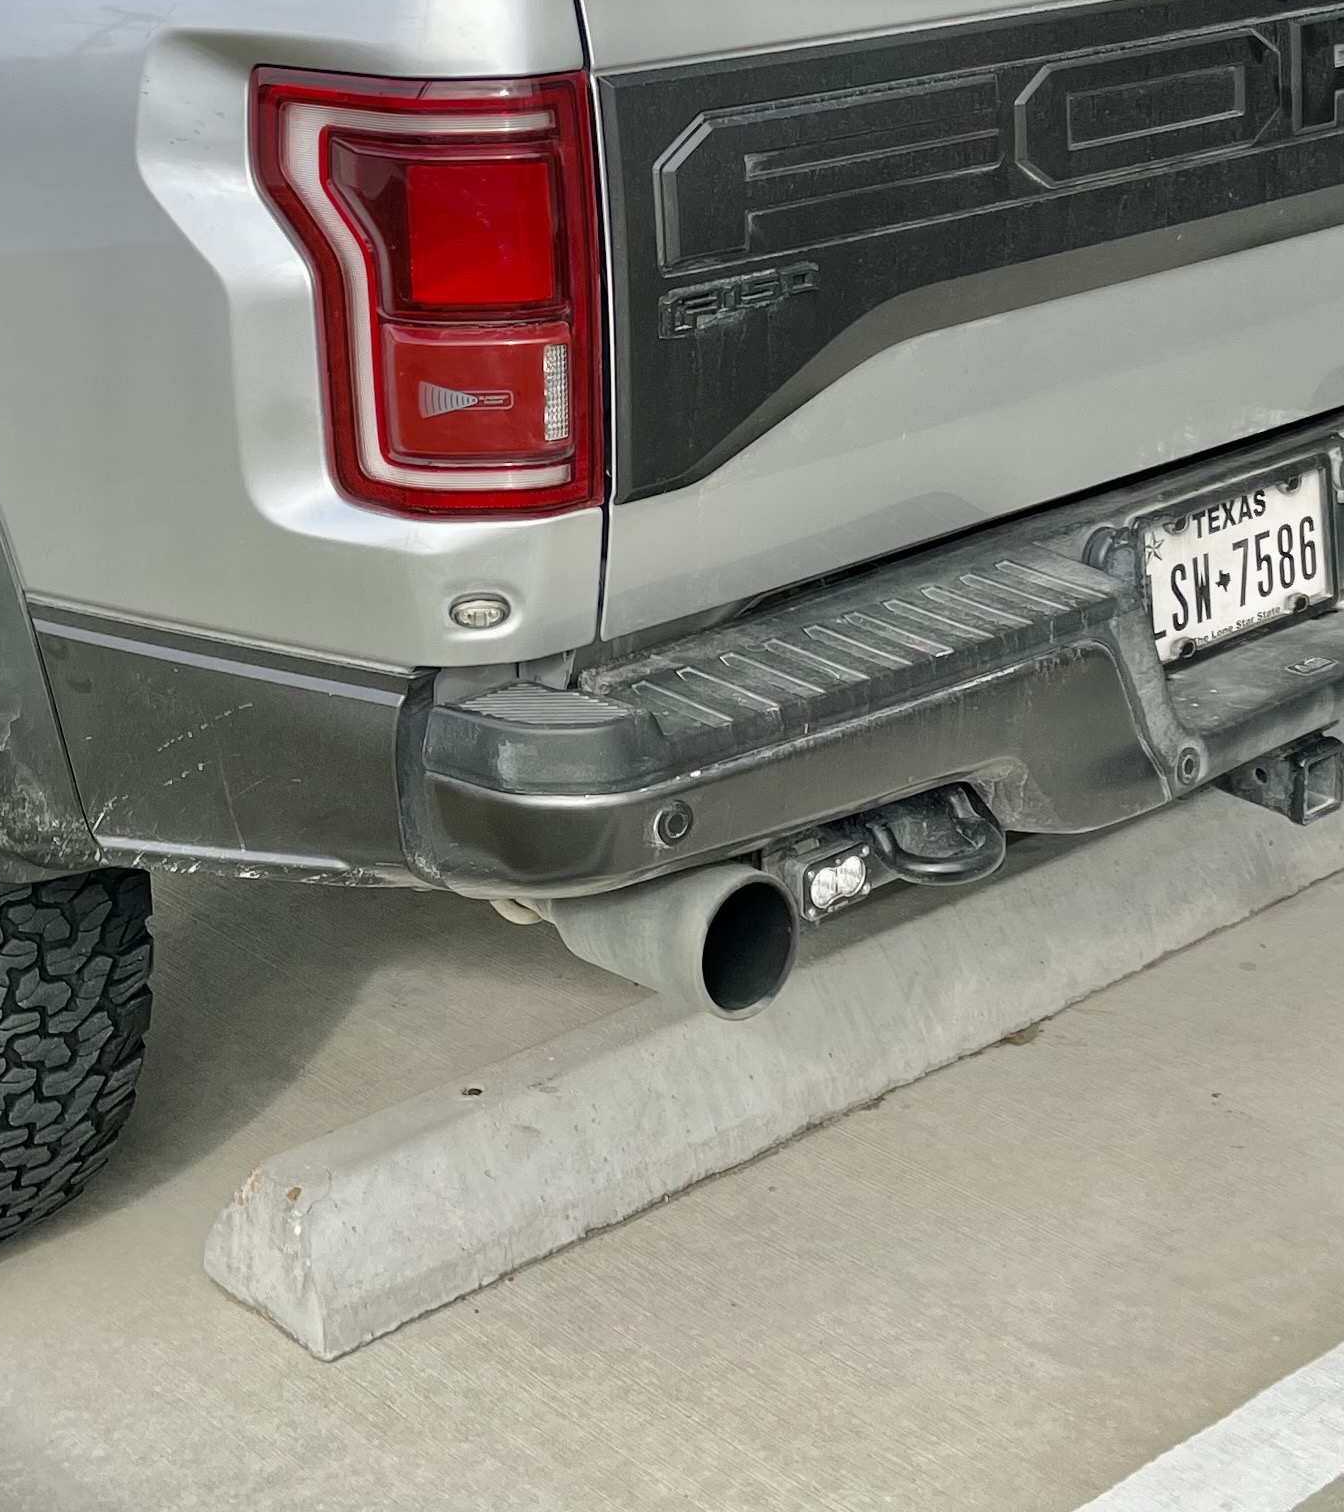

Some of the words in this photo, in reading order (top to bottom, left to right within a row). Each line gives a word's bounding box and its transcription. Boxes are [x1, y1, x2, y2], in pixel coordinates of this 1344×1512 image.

[1192, 489, 1266, 538] TEXAS
[1232, 515, 1317, 607] 7586
[1210, 624, 1234, 640] Lone
[1235, 615, 1256, 630] Star
[1256, 605, 1282, 623] State
